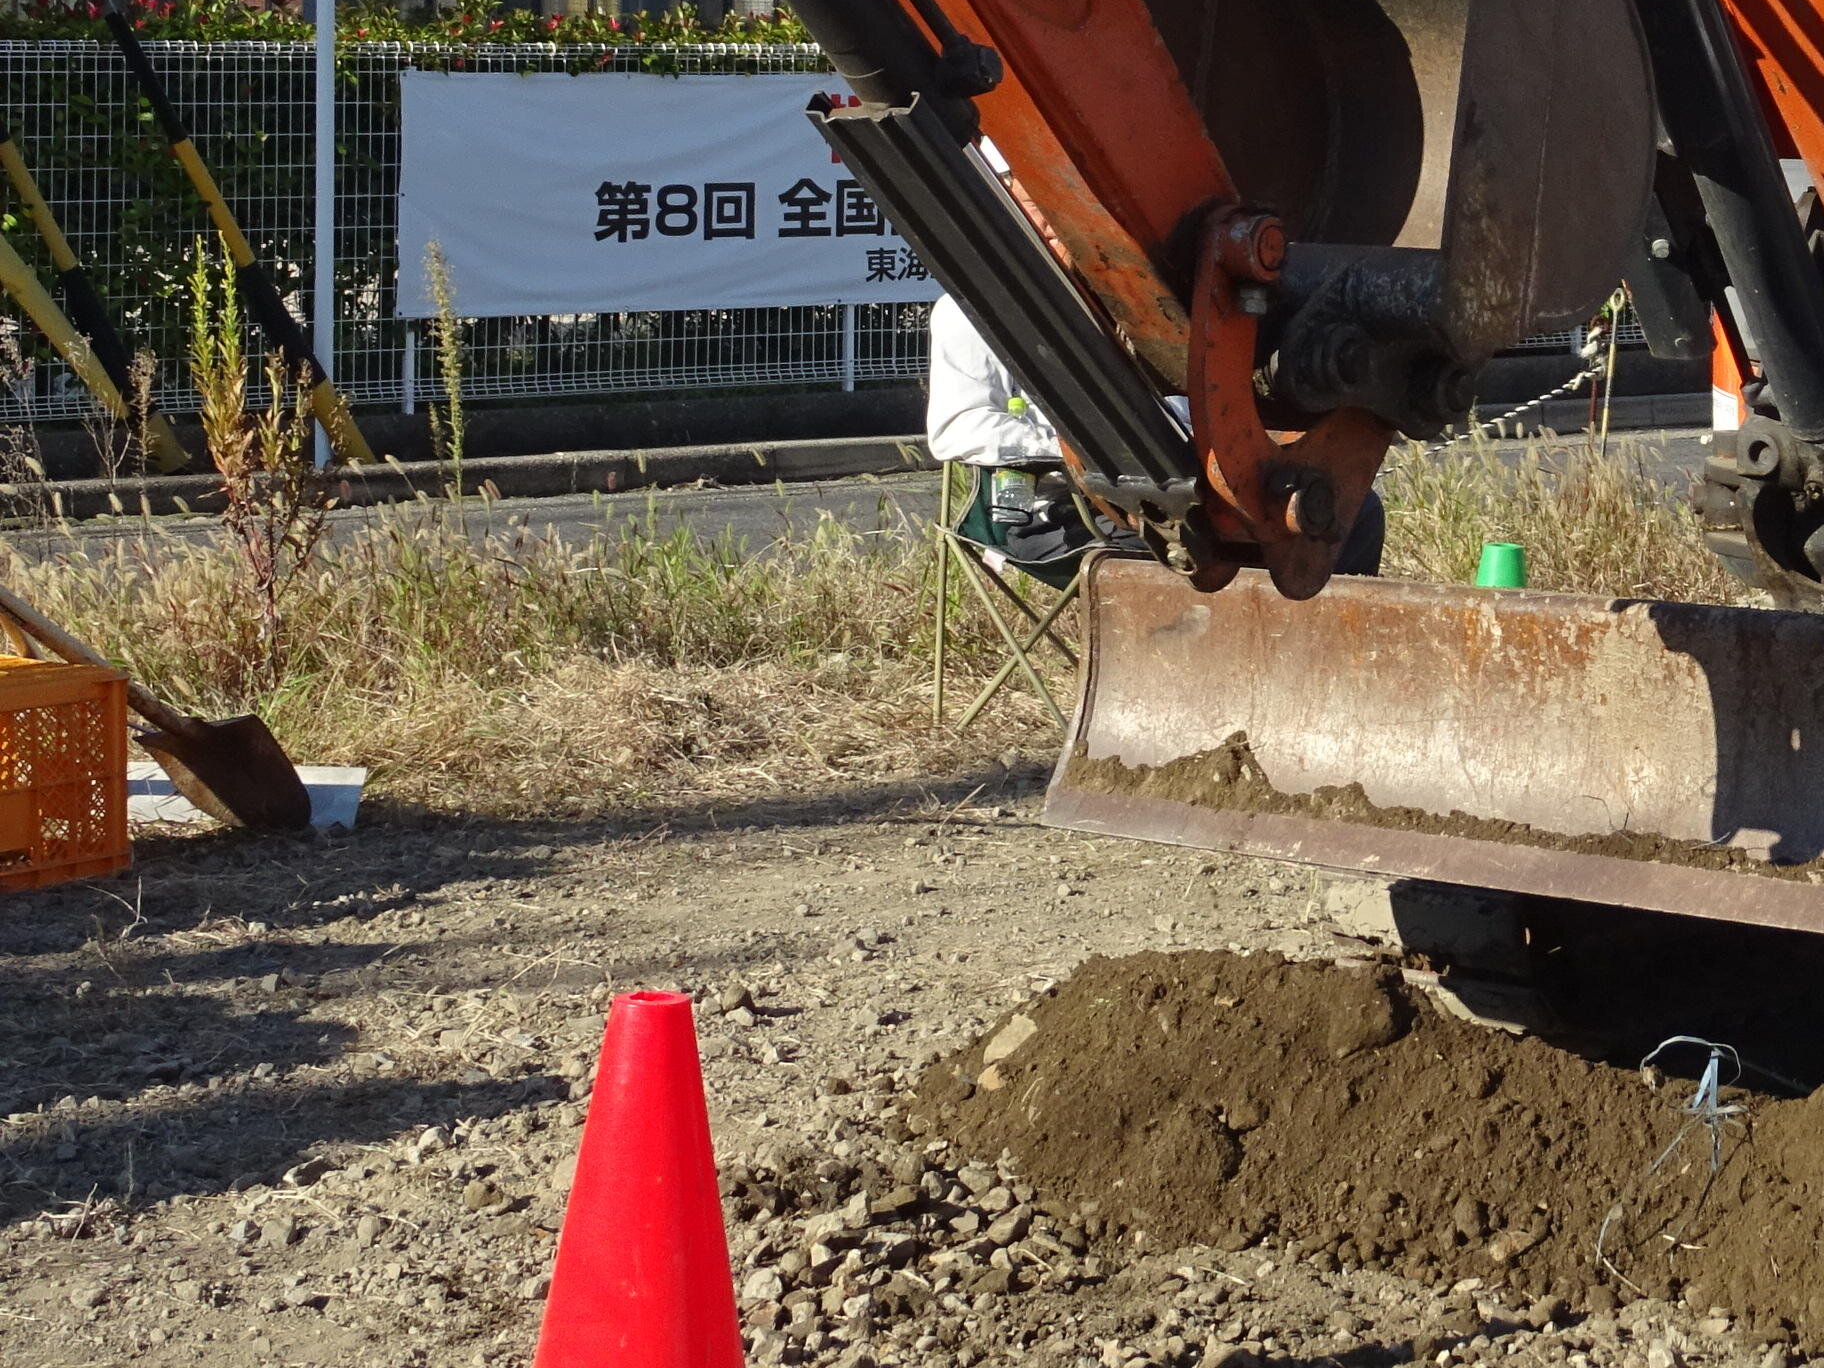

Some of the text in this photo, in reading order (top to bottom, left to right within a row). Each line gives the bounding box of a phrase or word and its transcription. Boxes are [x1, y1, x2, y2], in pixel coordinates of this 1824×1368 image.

[594, 177, 906, 243] 第8回 全国
[865, 246, 937, 282] 東海
